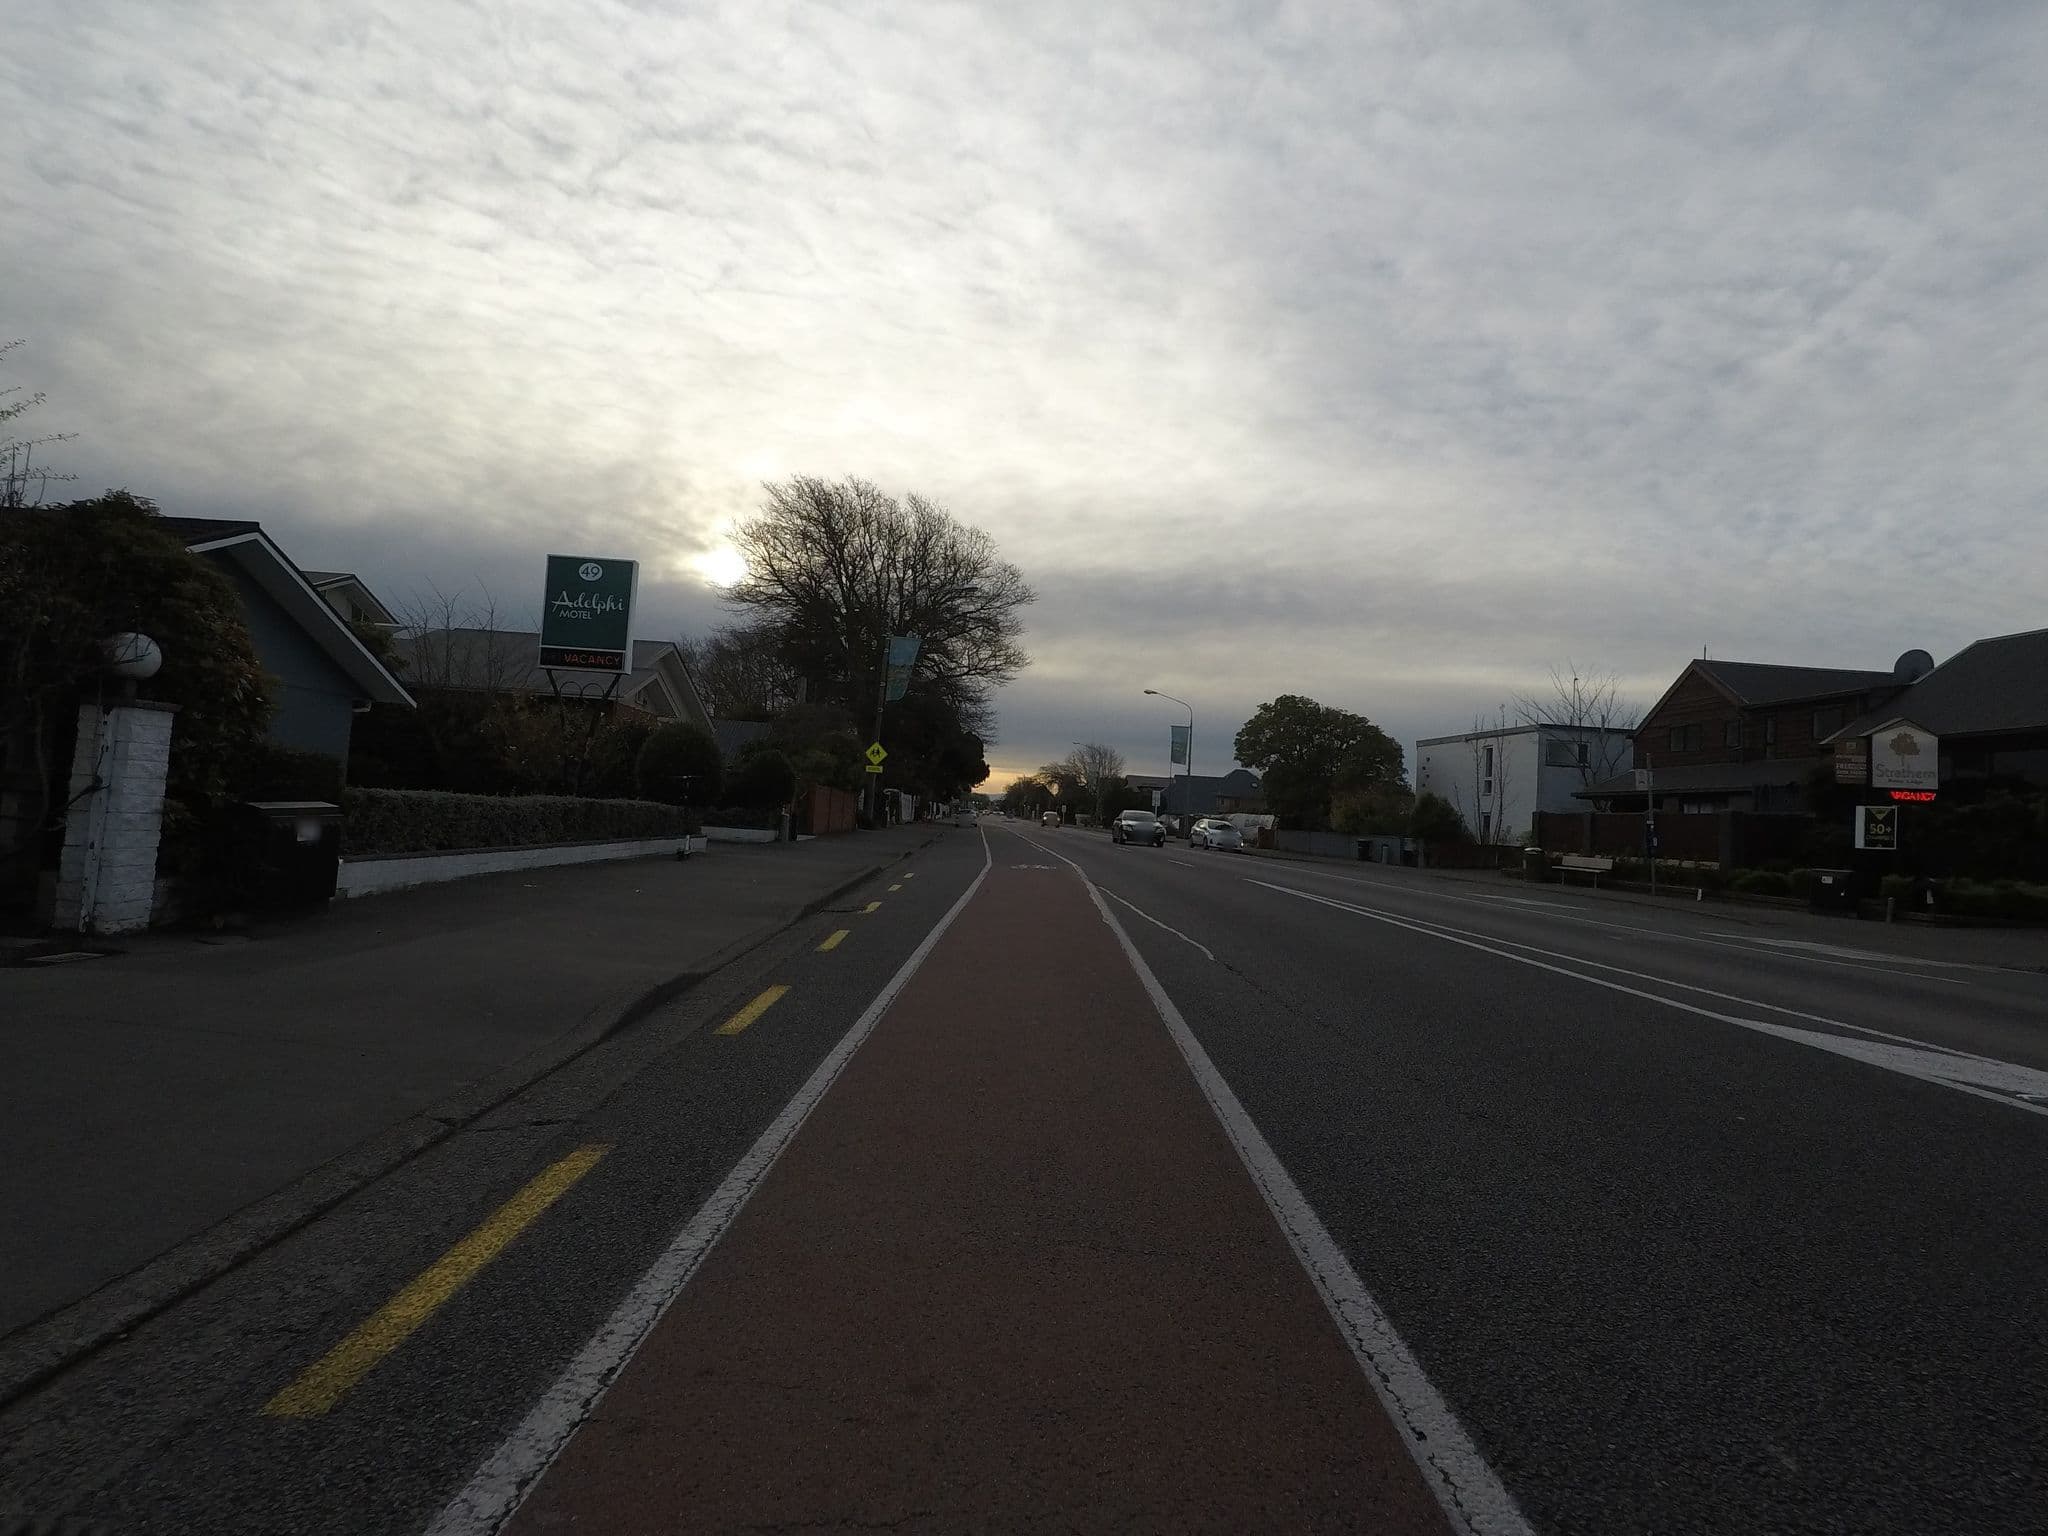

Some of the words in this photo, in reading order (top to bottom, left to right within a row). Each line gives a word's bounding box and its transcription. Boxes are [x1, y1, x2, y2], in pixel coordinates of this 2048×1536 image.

[580, 565, 600, 578] 49
[552, 591, 625, 614] Adelphi
[559, 610, 593, 620] MOTEL
[564, 653, 620, 666] VACANCY
